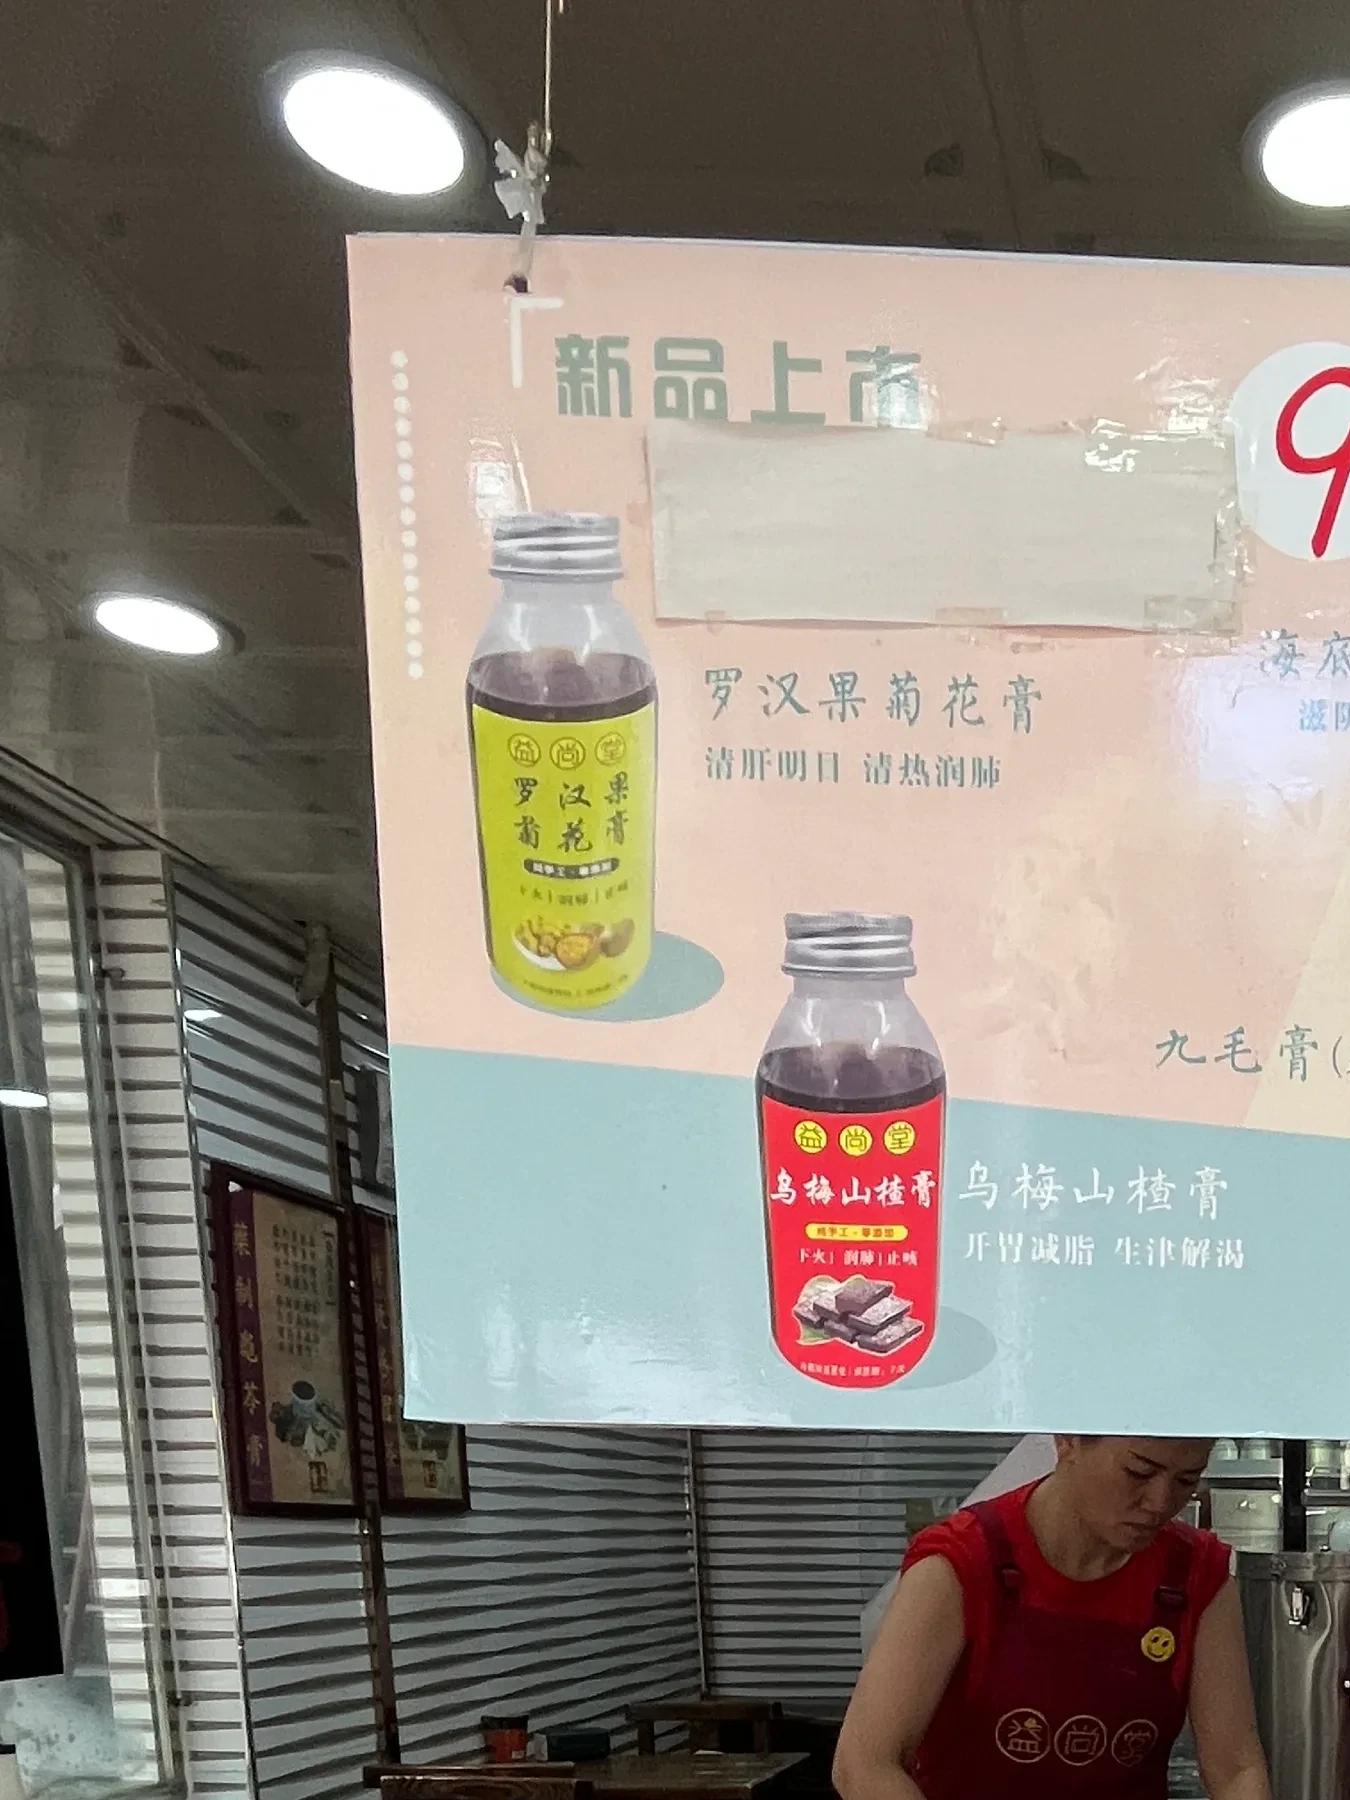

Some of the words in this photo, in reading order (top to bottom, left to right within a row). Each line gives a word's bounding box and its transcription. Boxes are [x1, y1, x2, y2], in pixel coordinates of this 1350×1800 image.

[703, 667, 1042, 734] 罗汉果菊花膏
[863, 752, 1001, 788] 清热润肺
[513, 771, 630, 810] 罗汉果
[770, 1166, 937, 1208] 乌梅山楂膏
[958, 1159, 1229, 1221] 乌梅山楂膏
[964, 1230, 1096, 1267] 开胃减脂
[1114, 1236, 1246, 1269] 生津解渴
